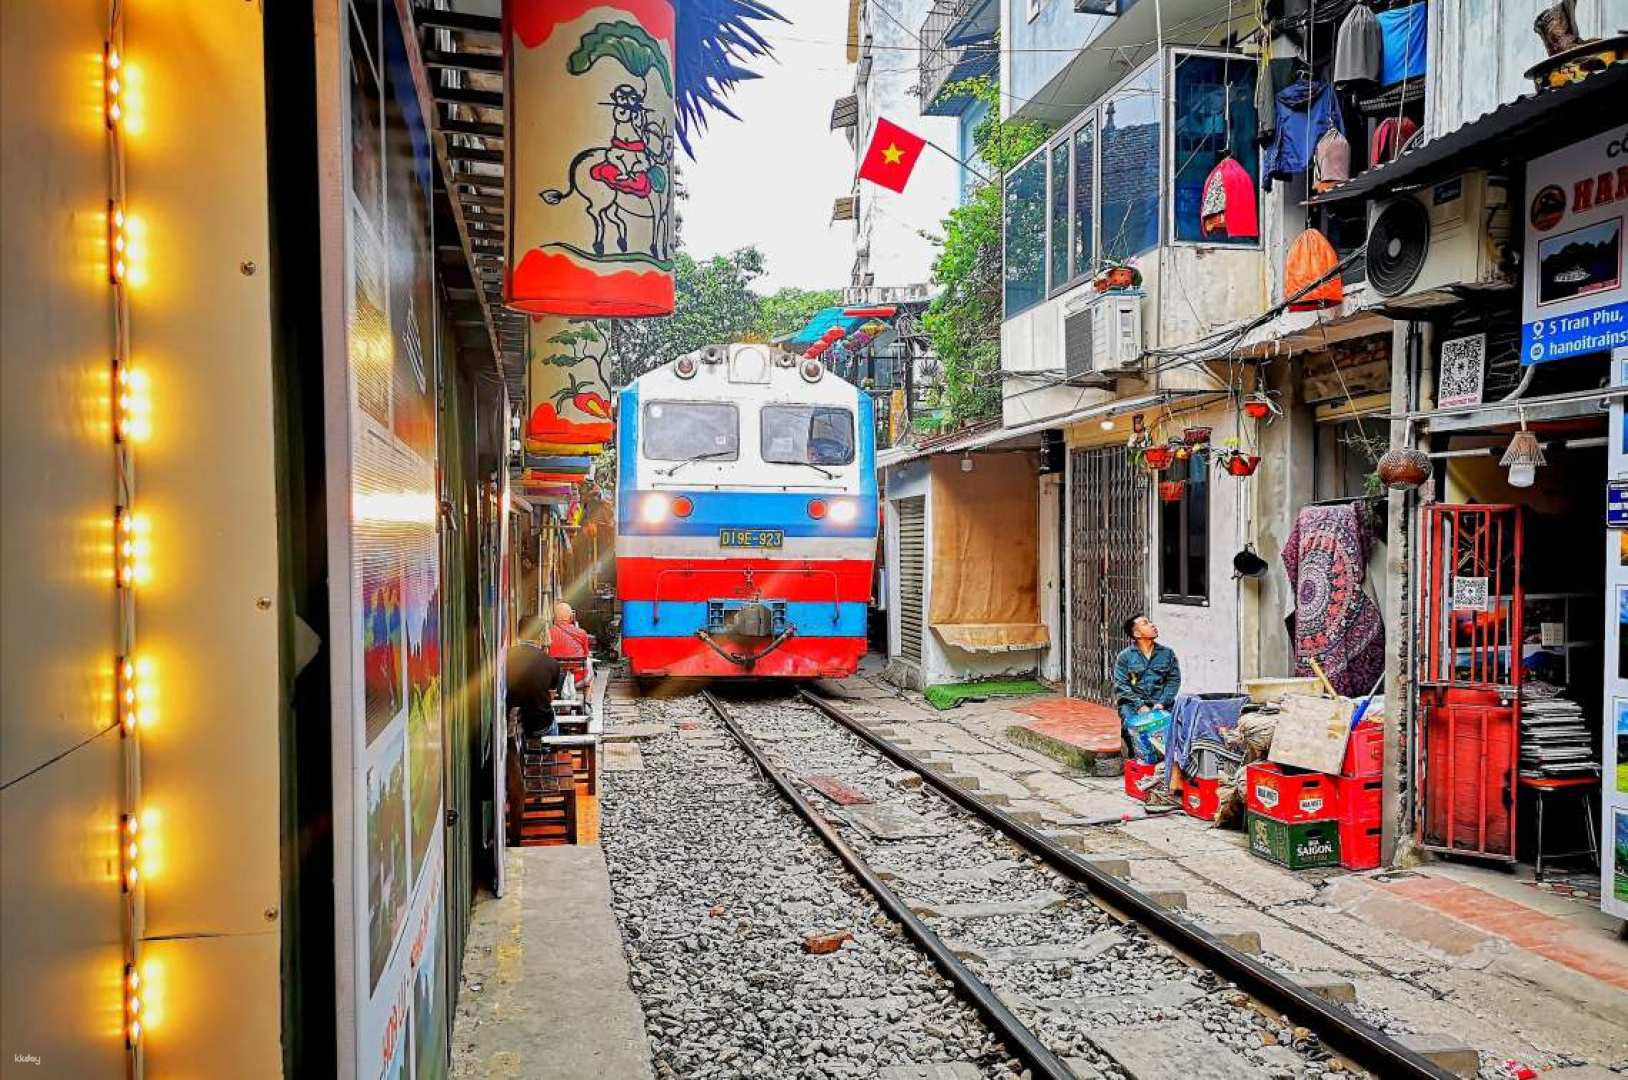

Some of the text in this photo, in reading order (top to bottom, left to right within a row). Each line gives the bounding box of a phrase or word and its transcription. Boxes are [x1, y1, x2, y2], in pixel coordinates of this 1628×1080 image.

[1550, 309, 1623, 335] 5 Tran Phu,
[722, 531, 782, 545] D19E-923
